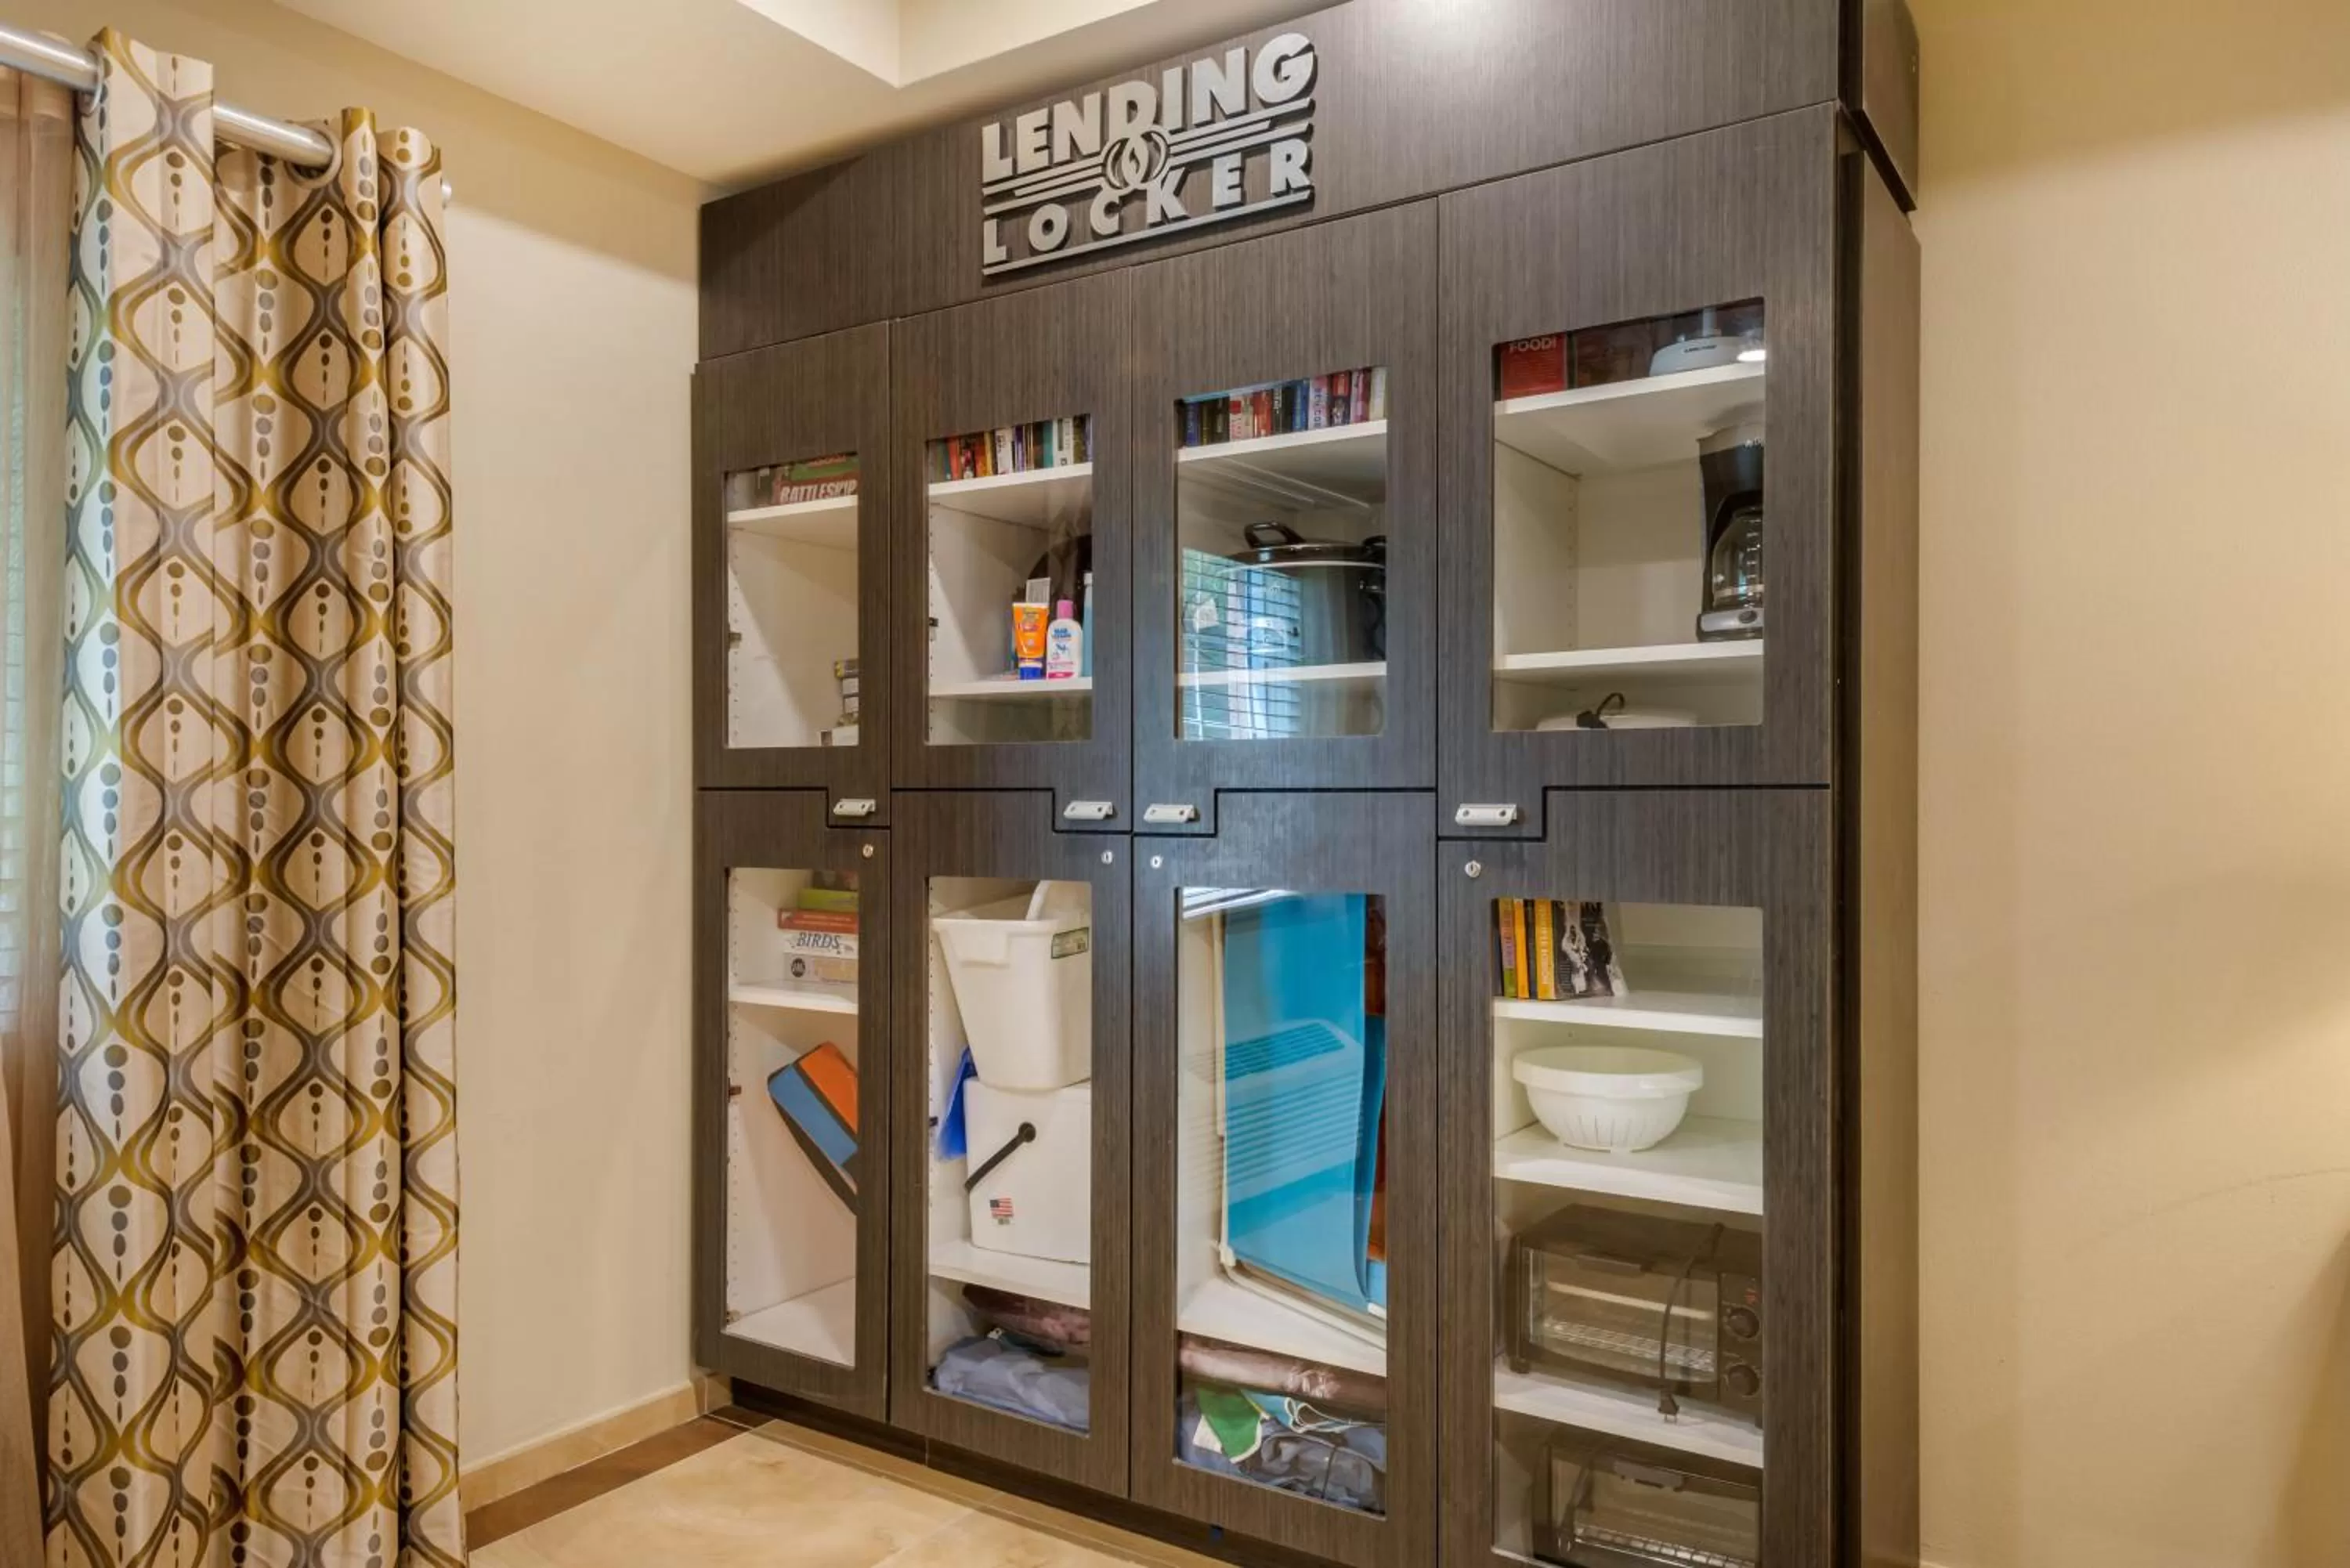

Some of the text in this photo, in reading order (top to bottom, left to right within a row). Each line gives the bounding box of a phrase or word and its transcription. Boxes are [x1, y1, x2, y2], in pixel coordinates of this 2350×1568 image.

[982, 32, 1314, 182] LENDING
[982, 139, 1314, 266] LOCKER
[780, 479, 858, 504] BATTLESHIP
[797, 932, 841, 950] BIRDS
